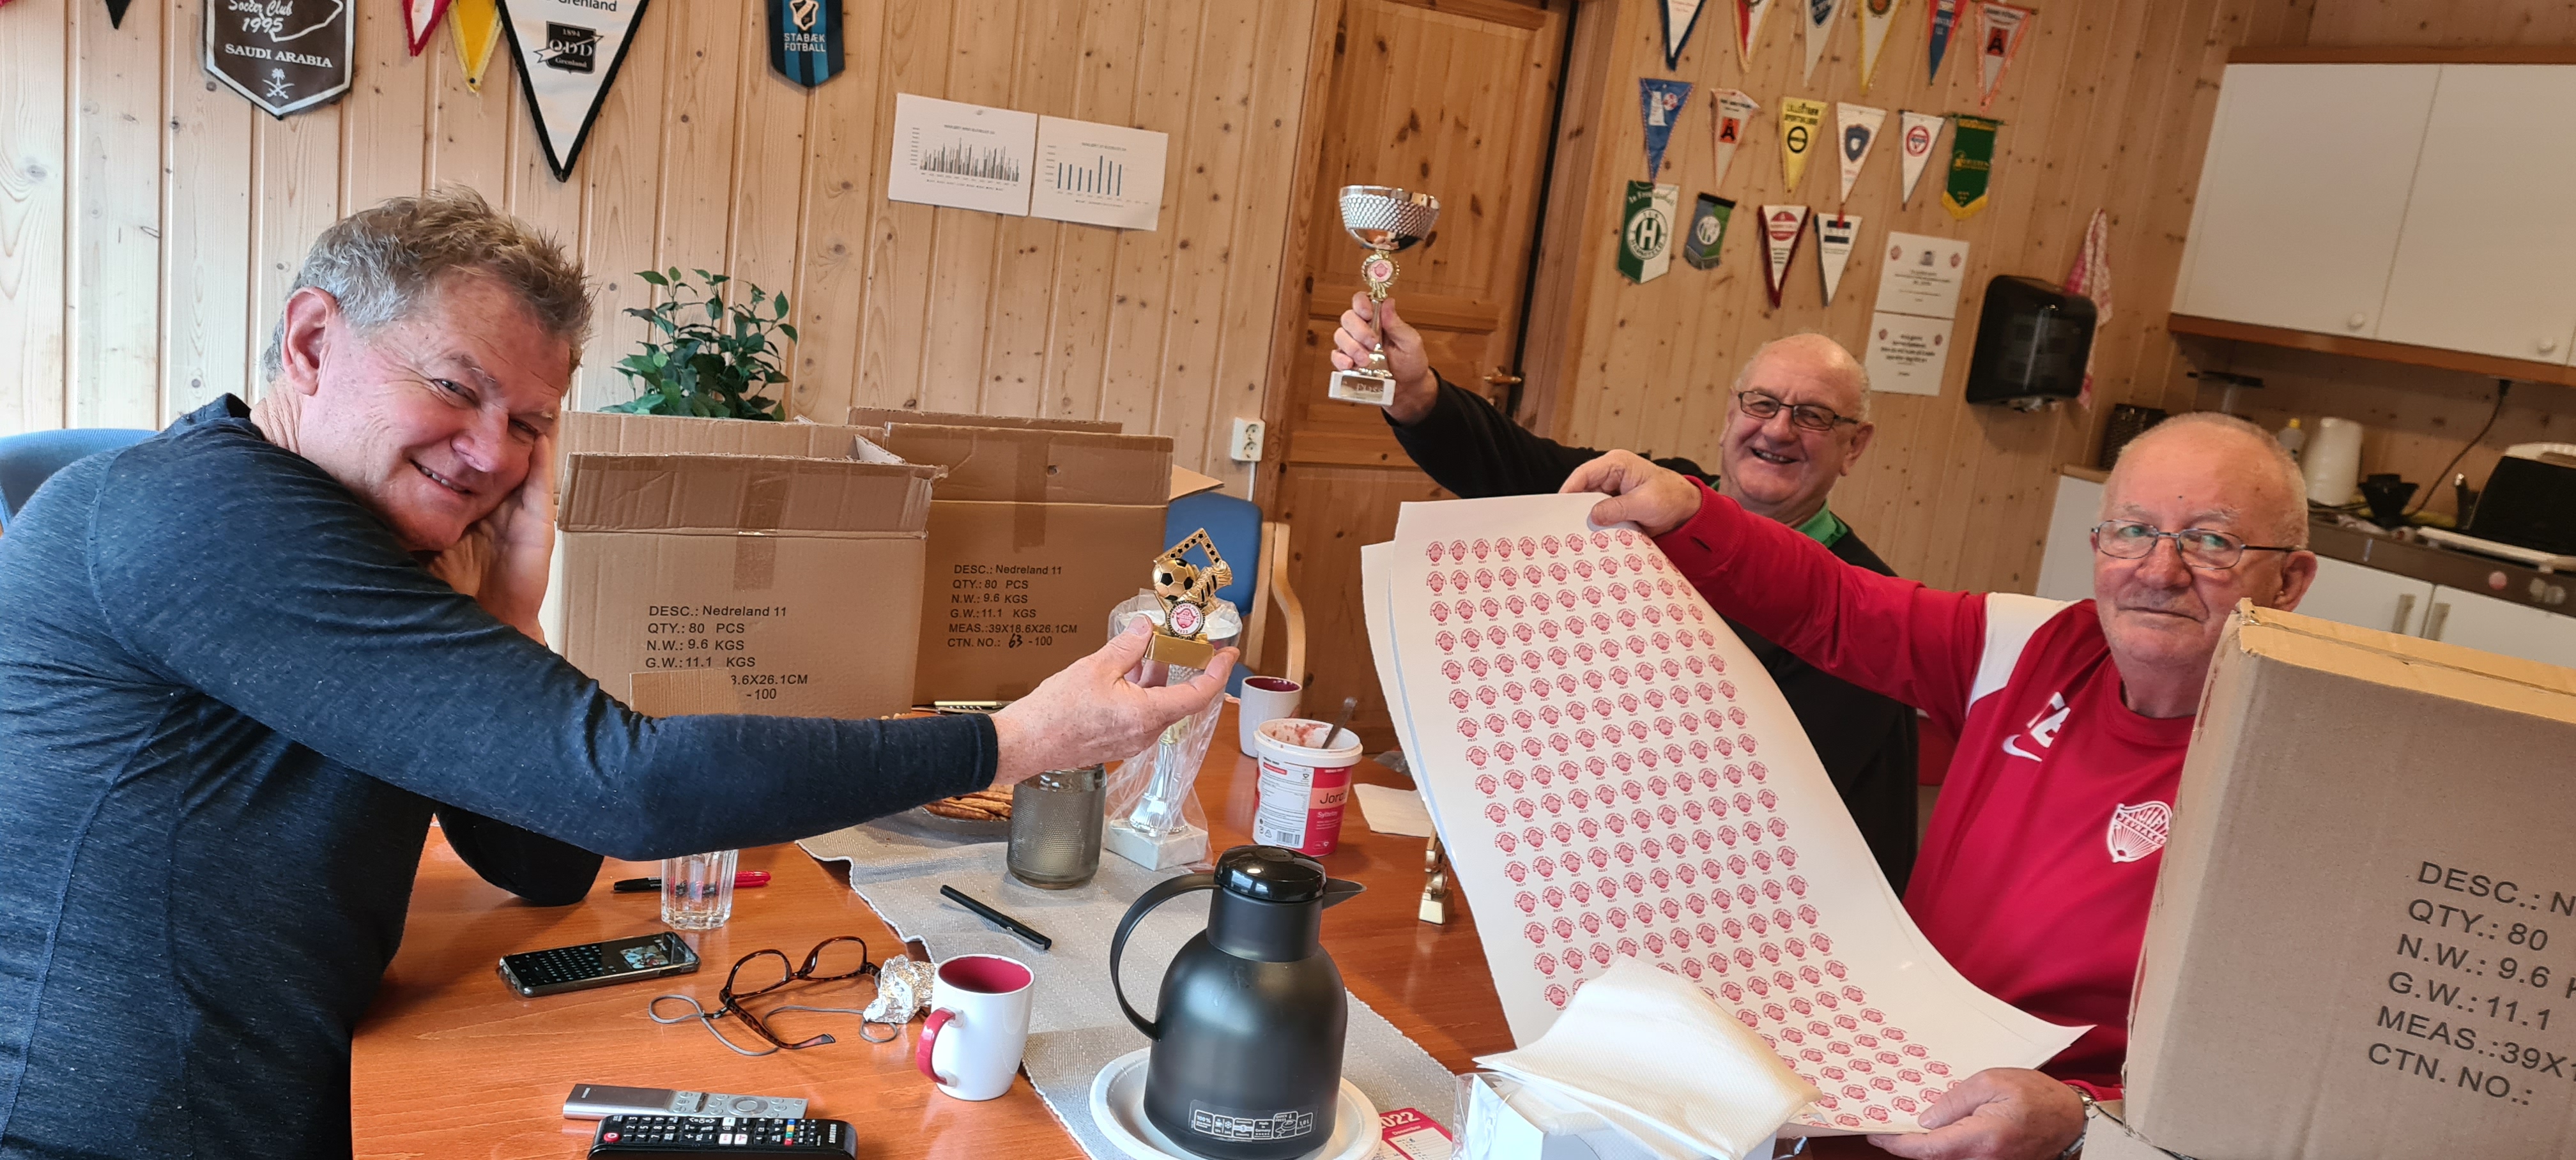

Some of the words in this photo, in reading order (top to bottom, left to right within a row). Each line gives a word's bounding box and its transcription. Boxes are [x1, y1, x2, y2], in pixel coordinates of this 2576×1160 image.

[228, 0, 263, 14] Soccer
[266, 0, 293, 16] Club
[242, 17, 284, 33] 1995
[562, 28, 581, 37] 1894
[784, 33, 825, 43] STABÆK
[785, 42, 826, 52] FOTBALL
[225, 43, 272, 59] SAUDI
[275, 51, 333, 68] ARABIA
[555, 57, 587, 68] Grenland
[954, 565, 992, 574] DESC.:
[995, 564, 1048, 575] Nedreland
[1051, 566, 1062, 575] 11
[953, 579, 981, 589] QTY.:
[985, 579, 997, 589] 80
[1006, 580, 1029, 589] PCS
[951, 594, 979, 604] N.W.:
[983, 593, 999, 602] 9.6
[1004, 595, 1028, 604] KGS
[648, 606, 698, 617] DESC.:
[703, 605, 770, 617] Nedreland
[774, 607, 786, 616] 11
[1013, 609, 1036, 618] KGS
[647, 623, 685, 634] QTY.:
[689, 623, 705, 634] 80
[716, 623, 745, 634] PCS
[646, 640, 683, 652] N.W.:
[688, 639, 708, 650] 9.6
[715, 640, 744, 651] KGS
[726, 657, 756, 668] KGS
[2418, 860, 2540, 911] DESC.:
[2409, 899, 2499, 940] QTY.:
[2508, 922, 2549, 951] 80
[2396, 933, 2486, 975] N.W.:
[2498, 957, 2550, 988] 9.6
[2388, 972, 2477, 1013] G.W.:
[2488, 996, 2551, 1030] 11.1
[1380, 1111, 1421, 1128] 022
[828, 1124, 837, 1143] SAMSUNG
